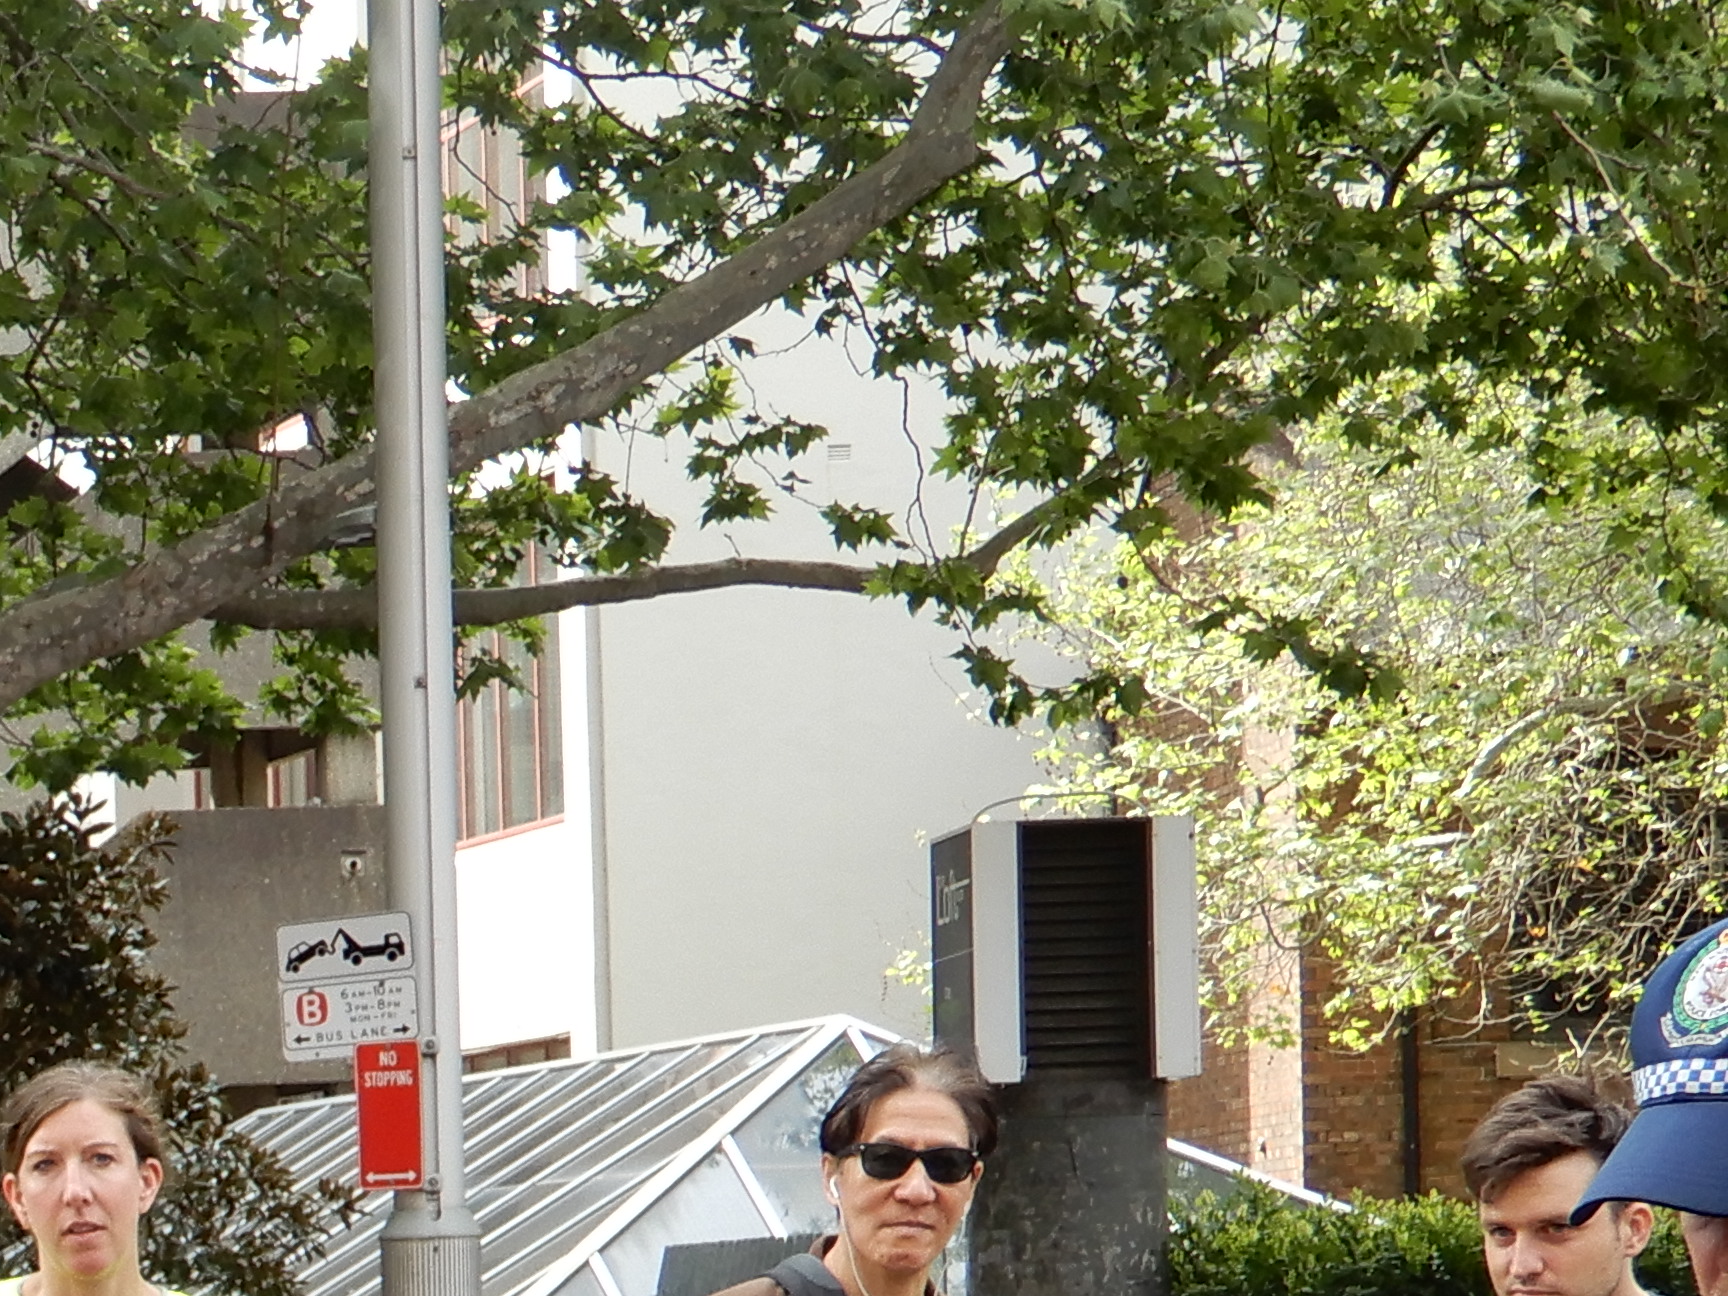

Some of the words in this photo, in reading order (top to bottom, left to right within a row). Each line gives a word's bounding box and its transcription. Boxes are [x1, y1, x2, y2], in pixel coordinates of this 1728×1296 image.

[315, 1030, 343, 1043] BUS
[350, 1026, 388, 1040] LANE
[378, 1050, 397, 1067] NO
[364, 1070, 413, 1088] STOPPING
